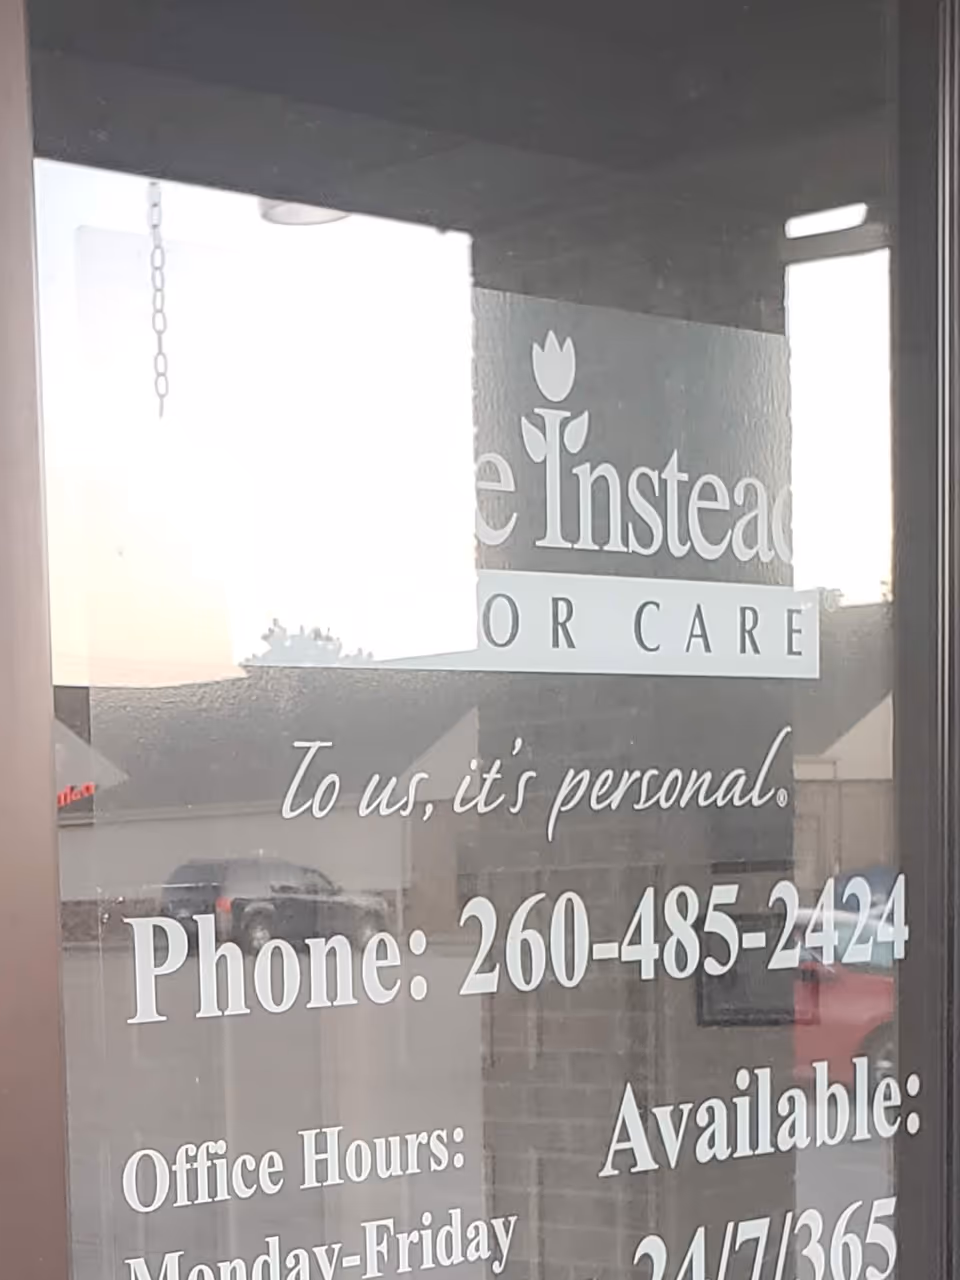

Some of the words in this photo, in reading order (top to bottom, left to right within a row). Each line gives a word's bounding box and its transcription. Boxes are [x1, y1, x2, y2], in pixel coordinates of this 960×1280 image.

[481, 592, 576, 649] OR
[633, 600, 803, 657] CARE
[281, 740, 341, 820] To
[358, 771, 431, 822] us,
[451, 737, 538, 815] it's
[125, 915, 429, 1026] Phone:
[458, 872, 910, 997] 260-485-2424
[597, 1055, 922, 1178] Available:
[122, 1139, 285, 1213] Office
[297, 1126, 465, 1190] Hours:
